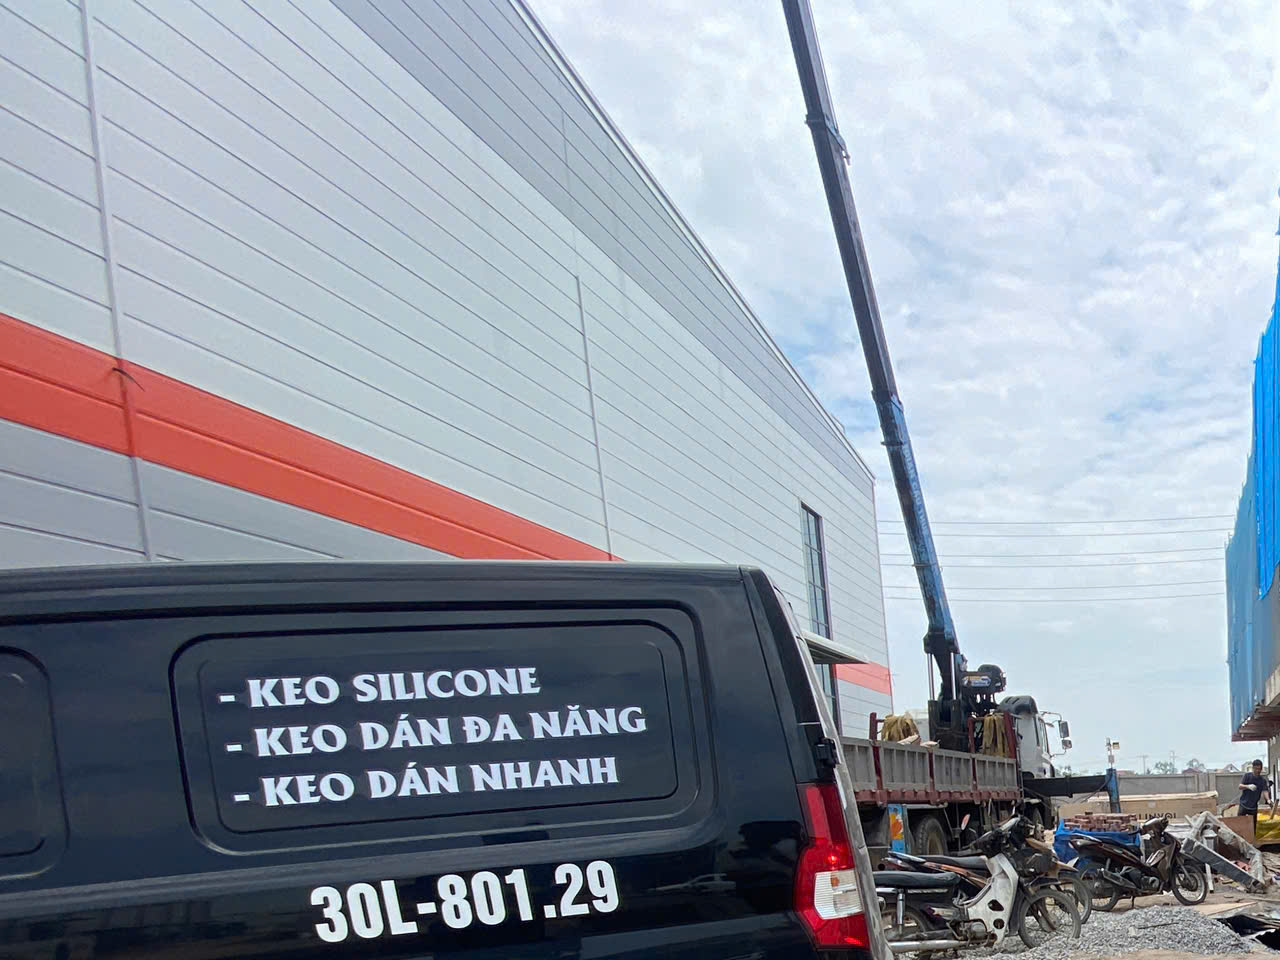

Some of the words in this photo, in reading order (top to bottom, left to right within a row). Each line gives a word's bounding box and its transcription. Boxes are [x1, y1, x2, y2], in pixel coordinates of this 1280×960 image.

[247, 676, 341, 708] KEO
[352, 667, 541, 703] SILICONE
[254, 724, 347, 757] KEO
[358, 713, 452, 750] DÁN
[462, 713, 523, 744] ĐA
[528, 704, 647, 739] NĂNG
[261, 773, 355, 807] KEO
[366, 761, 460, 799] DÁN
[470, 756, 619, 792] NHANH
[310, 860, 620, 943] 30L-801.29
